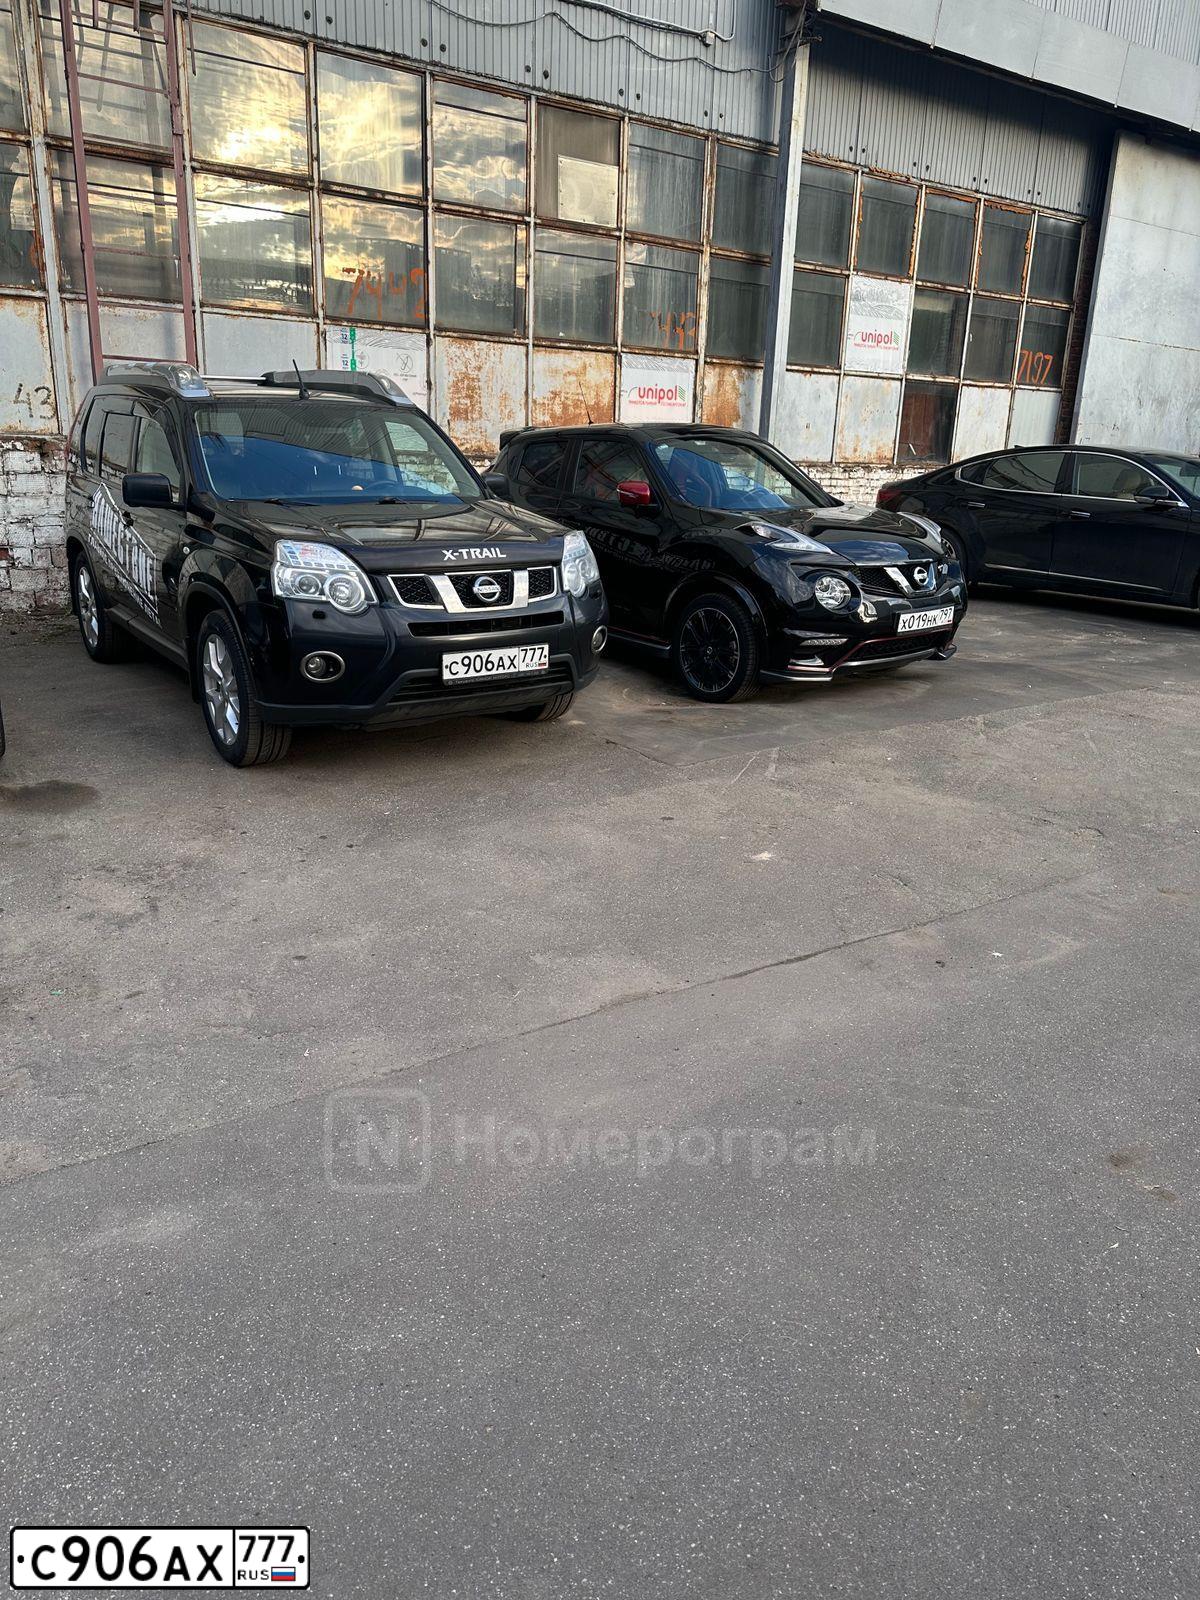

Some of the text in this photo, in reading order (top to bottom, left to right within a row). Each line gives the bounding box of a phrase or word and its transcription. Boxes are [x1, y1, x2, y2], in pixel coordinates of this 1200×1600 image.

[861, 329, 893, 347] unipol
[638, 384, 677, 403] unipol
[442, 548, 506, 561] X-TRAIL
[449, 647, 545, 675] С906АХ 777
